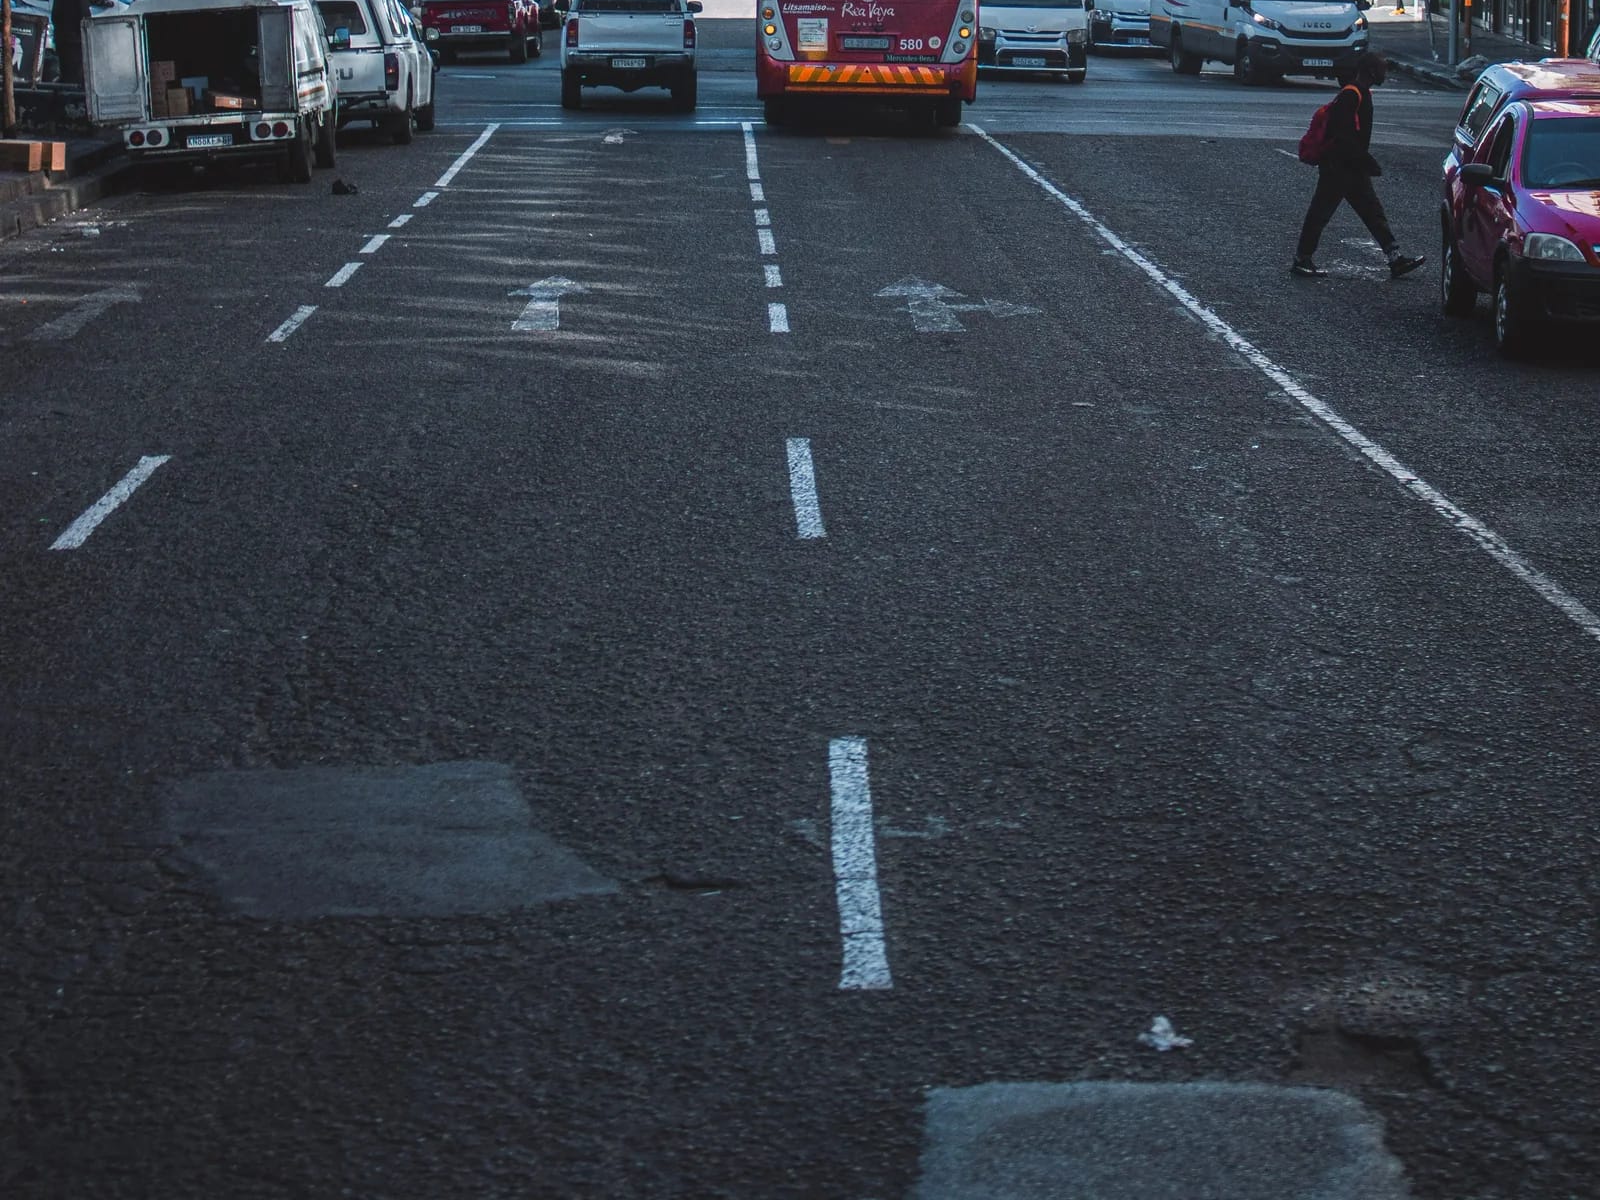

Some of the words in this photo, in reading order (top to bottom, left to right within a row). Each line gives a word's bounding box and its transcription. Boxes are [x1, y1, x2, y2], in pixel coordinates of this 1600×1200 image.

[842, 2, 866, 17] Rea
[868, 3, 895, 23] Vaya
[900, 39, 923, 50] 580
